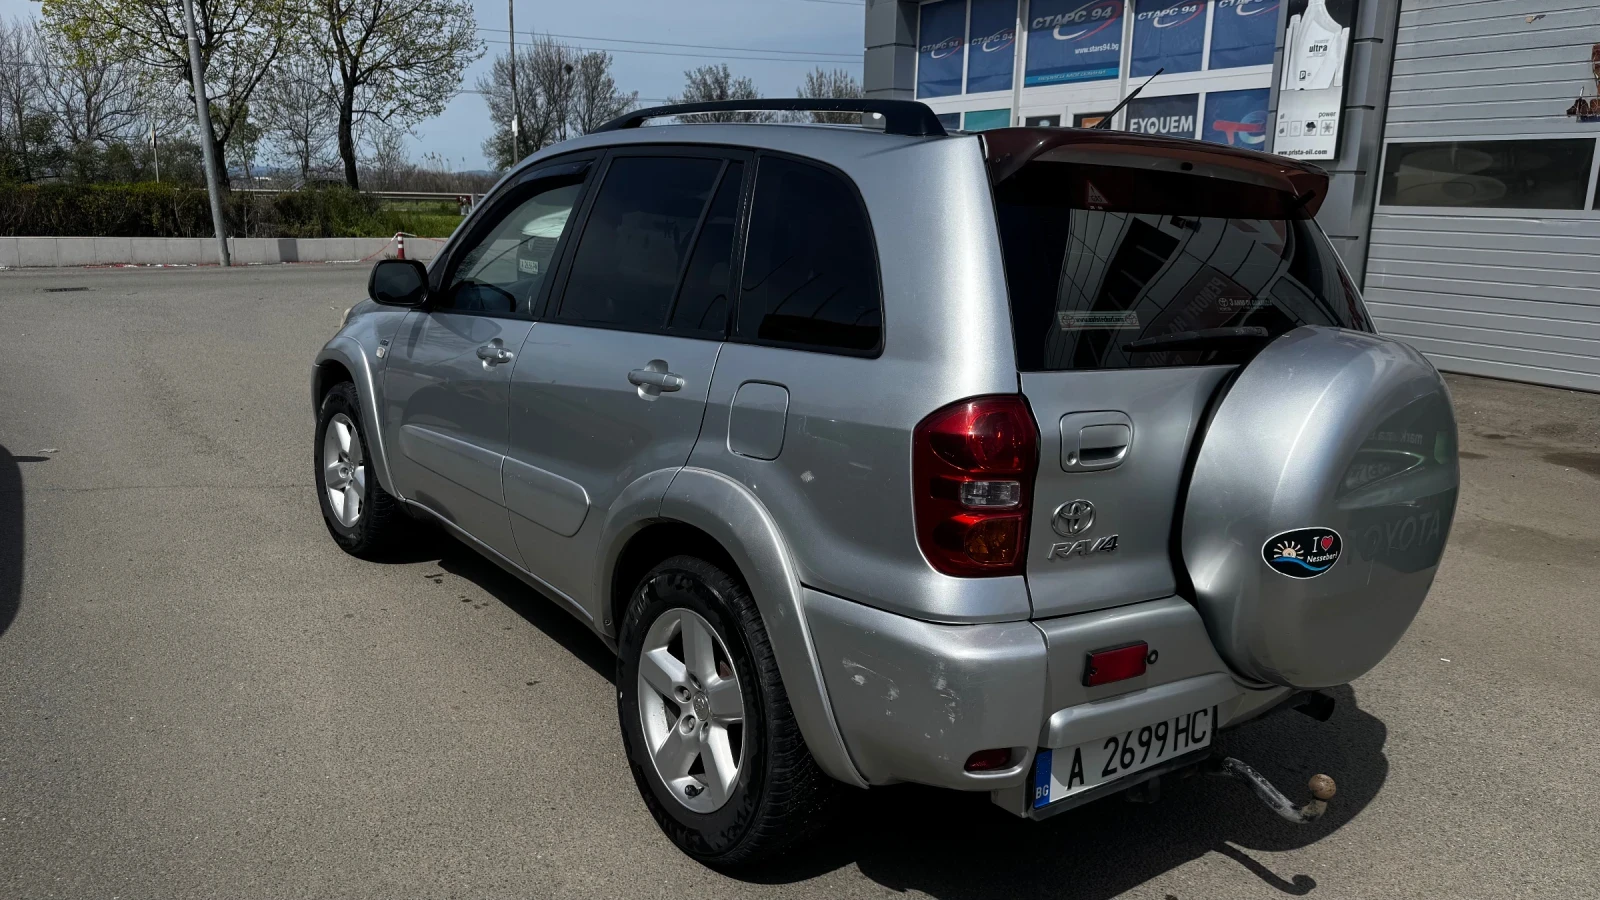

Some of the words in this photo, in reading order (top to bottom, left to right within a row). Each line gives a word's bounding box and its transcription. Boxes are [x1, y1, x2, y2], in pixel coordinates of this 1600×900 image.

[1218, 0, 1263, 8] СТА
[1032, 11, 1088, 30] СТАРС
[1091, 7, 1112, 20] 94
[1137, 8, 1178, 21] СТАРС
[1181, 4, 1197, 14] 94
[921, 41, 947, 53] СТАРС
[948, 39, 959, 48] 94
[971, 34, 1000, 46] СТАРС
[1002, 32, 1013, 41] 94
[1074, 43, 1119, 55] www.stars94.bg
[1308, 44, 1328, 53] ultra
[1318, 111, 1336, 119] power
[1129, 115, 1194, 135] EYQUEM
[1311, 536, 1320, 553] I
[1345, 509, 1441, 566] TOYOTA
[1046, 534, 1120, 560] RAV4
[1066, 747, 1085, 791] A
[1101, 720, 1169, 778] 2699
[1173, 709, 1208, 752] HC
[1035, 784, 1049, 800] BG
